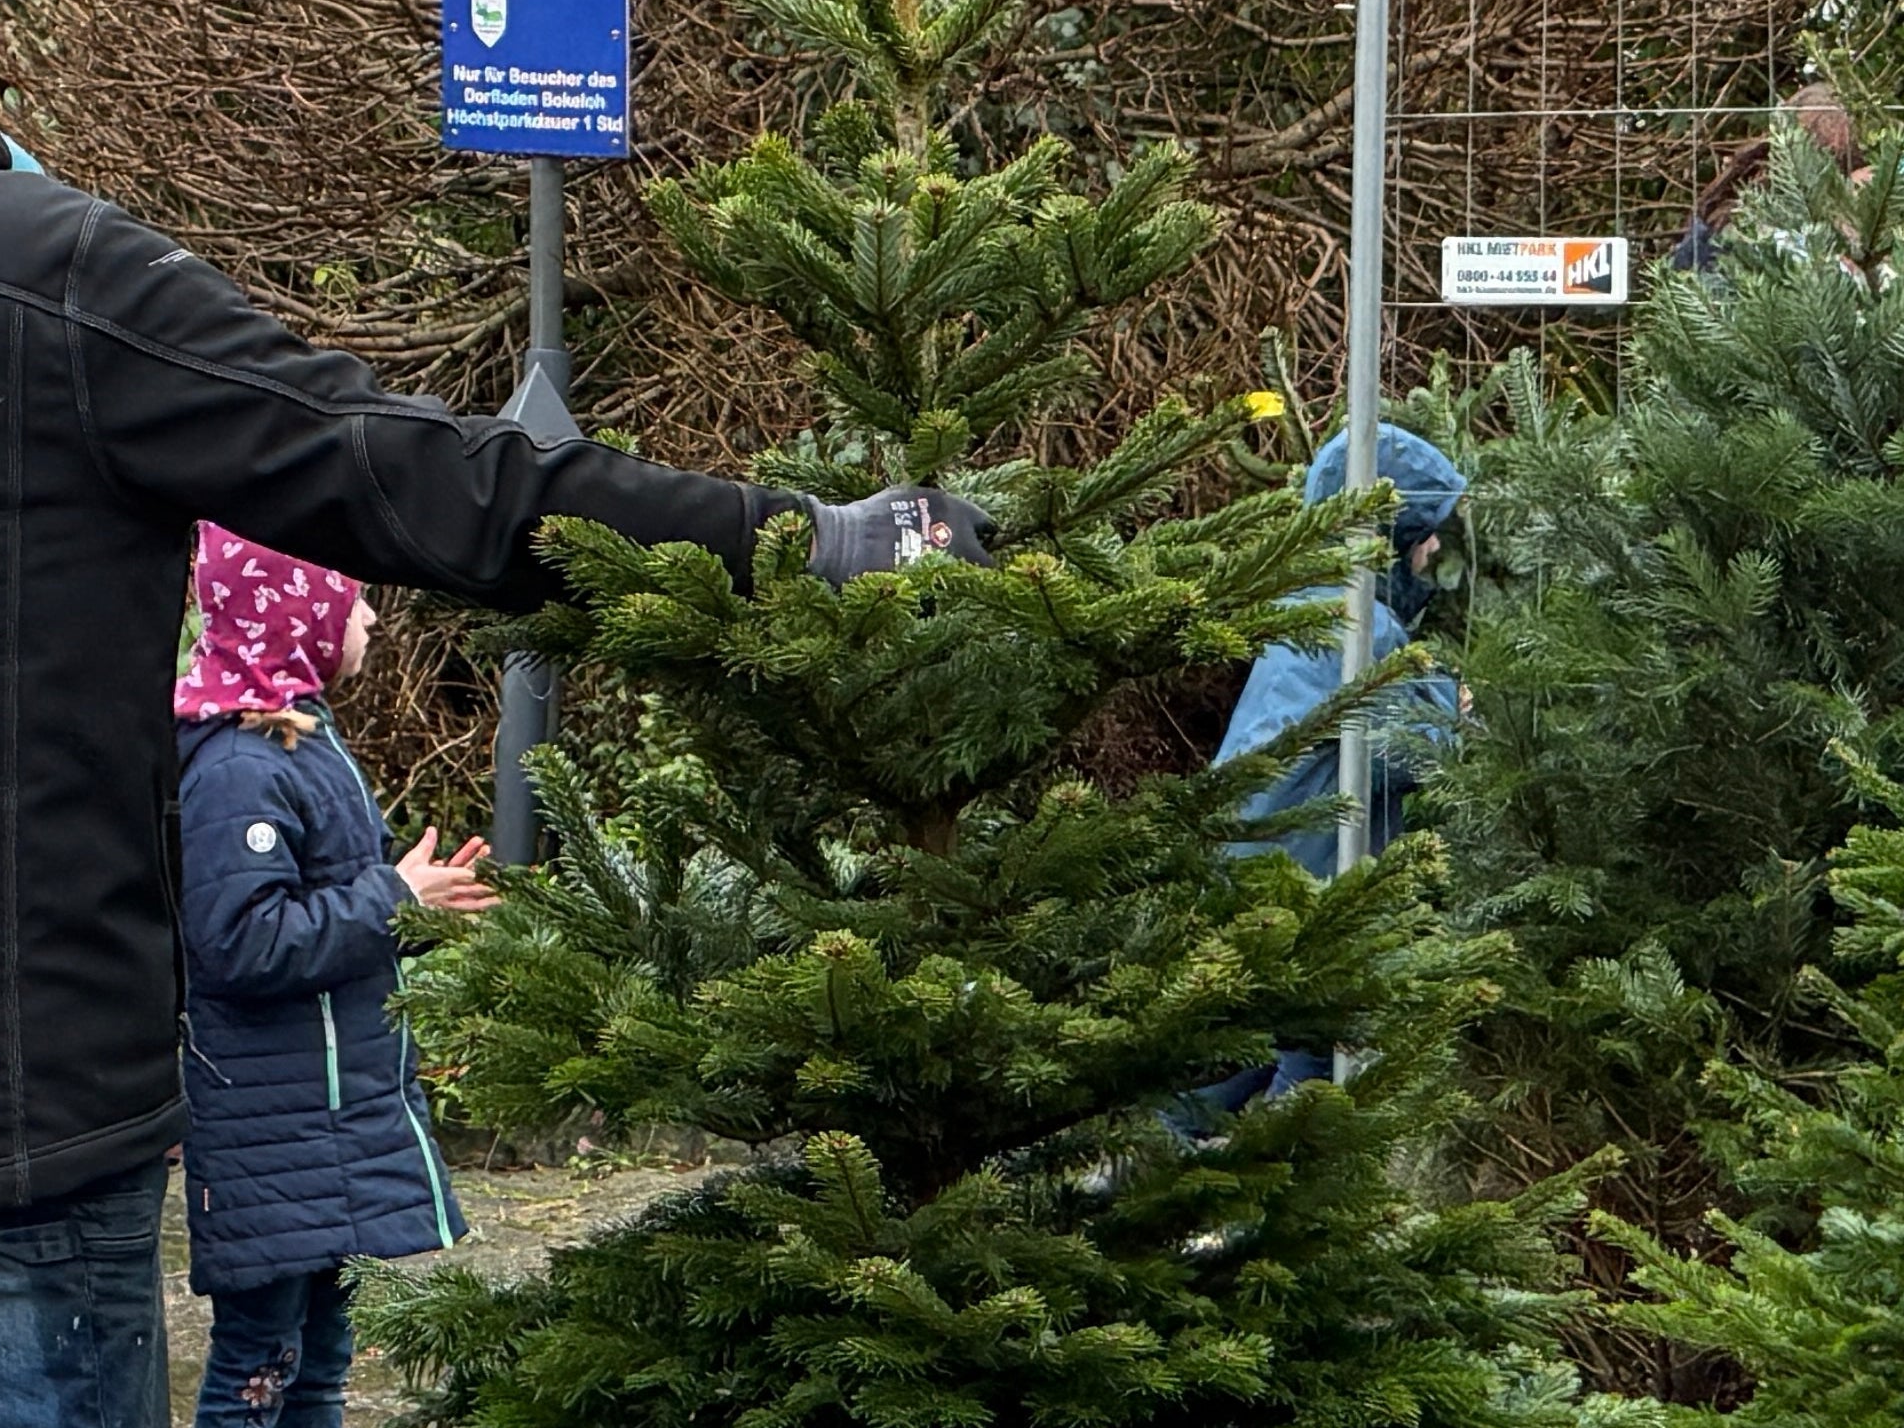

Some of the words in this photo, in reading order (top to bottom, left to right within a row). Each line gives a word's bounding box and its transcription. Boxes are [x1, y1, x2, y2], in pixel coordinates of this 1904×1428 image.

[453, 64, 481, 82] Nur
[484, 65, 506, 84] für
[509, 66, 585, 87] Besucher
[463, 87, 538, 106] Dorfladen
[447, 107, 580, 130] Höchstparkdauer
[583, 114, 592, 131] 1
[1567, 243, 1610, 287] HKL
